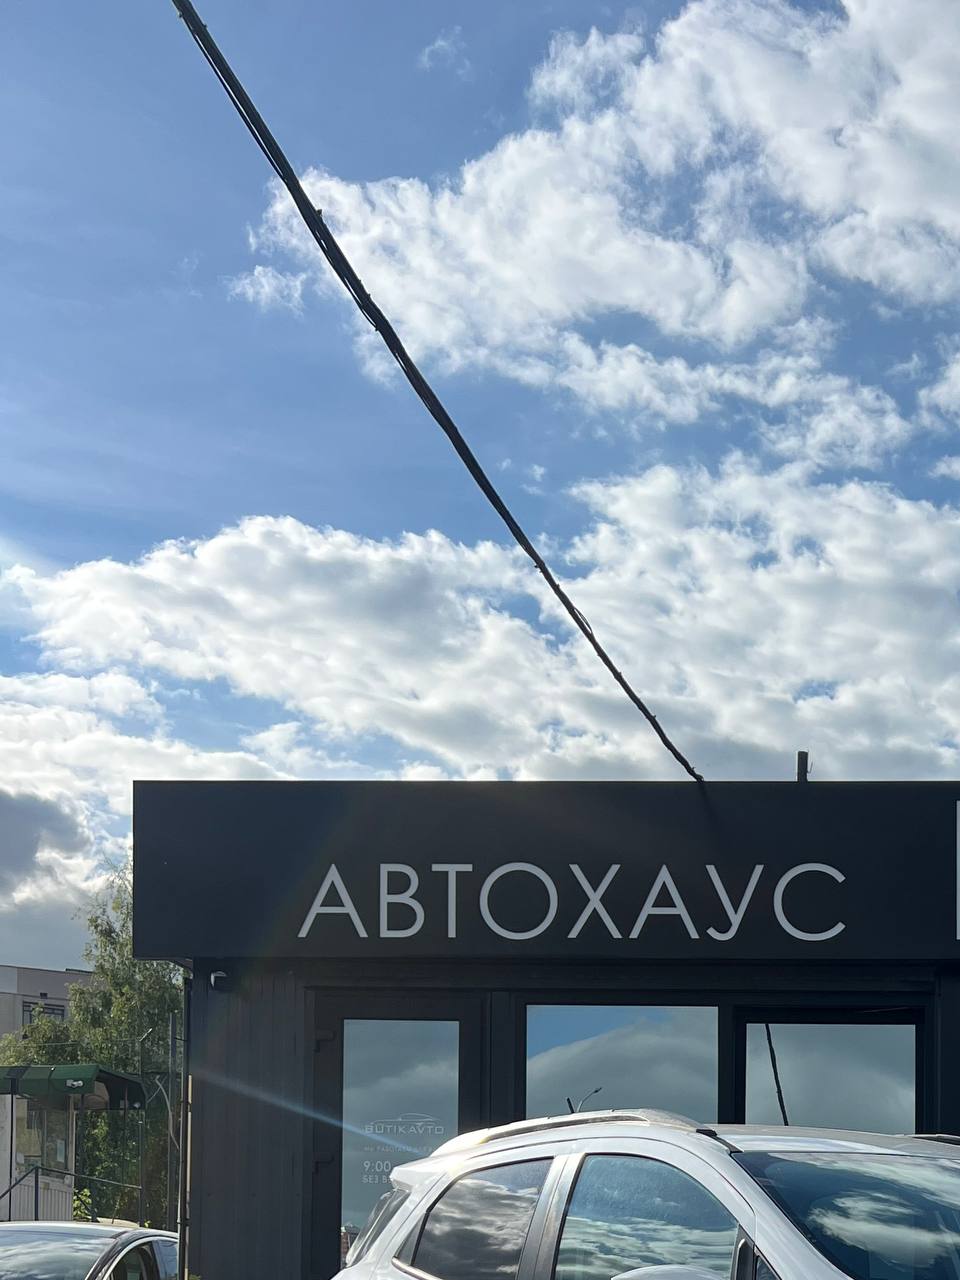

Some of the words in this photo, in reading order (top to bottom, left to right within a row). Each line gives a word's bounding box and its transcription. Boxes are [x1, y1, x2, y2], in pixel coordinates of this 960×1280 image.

[298, 862, 846, 942] АВТОХАУС
[365, 1124, 444, 1134] BUTIKAVTO
[363, 1160, 391, 1172] 9:00
